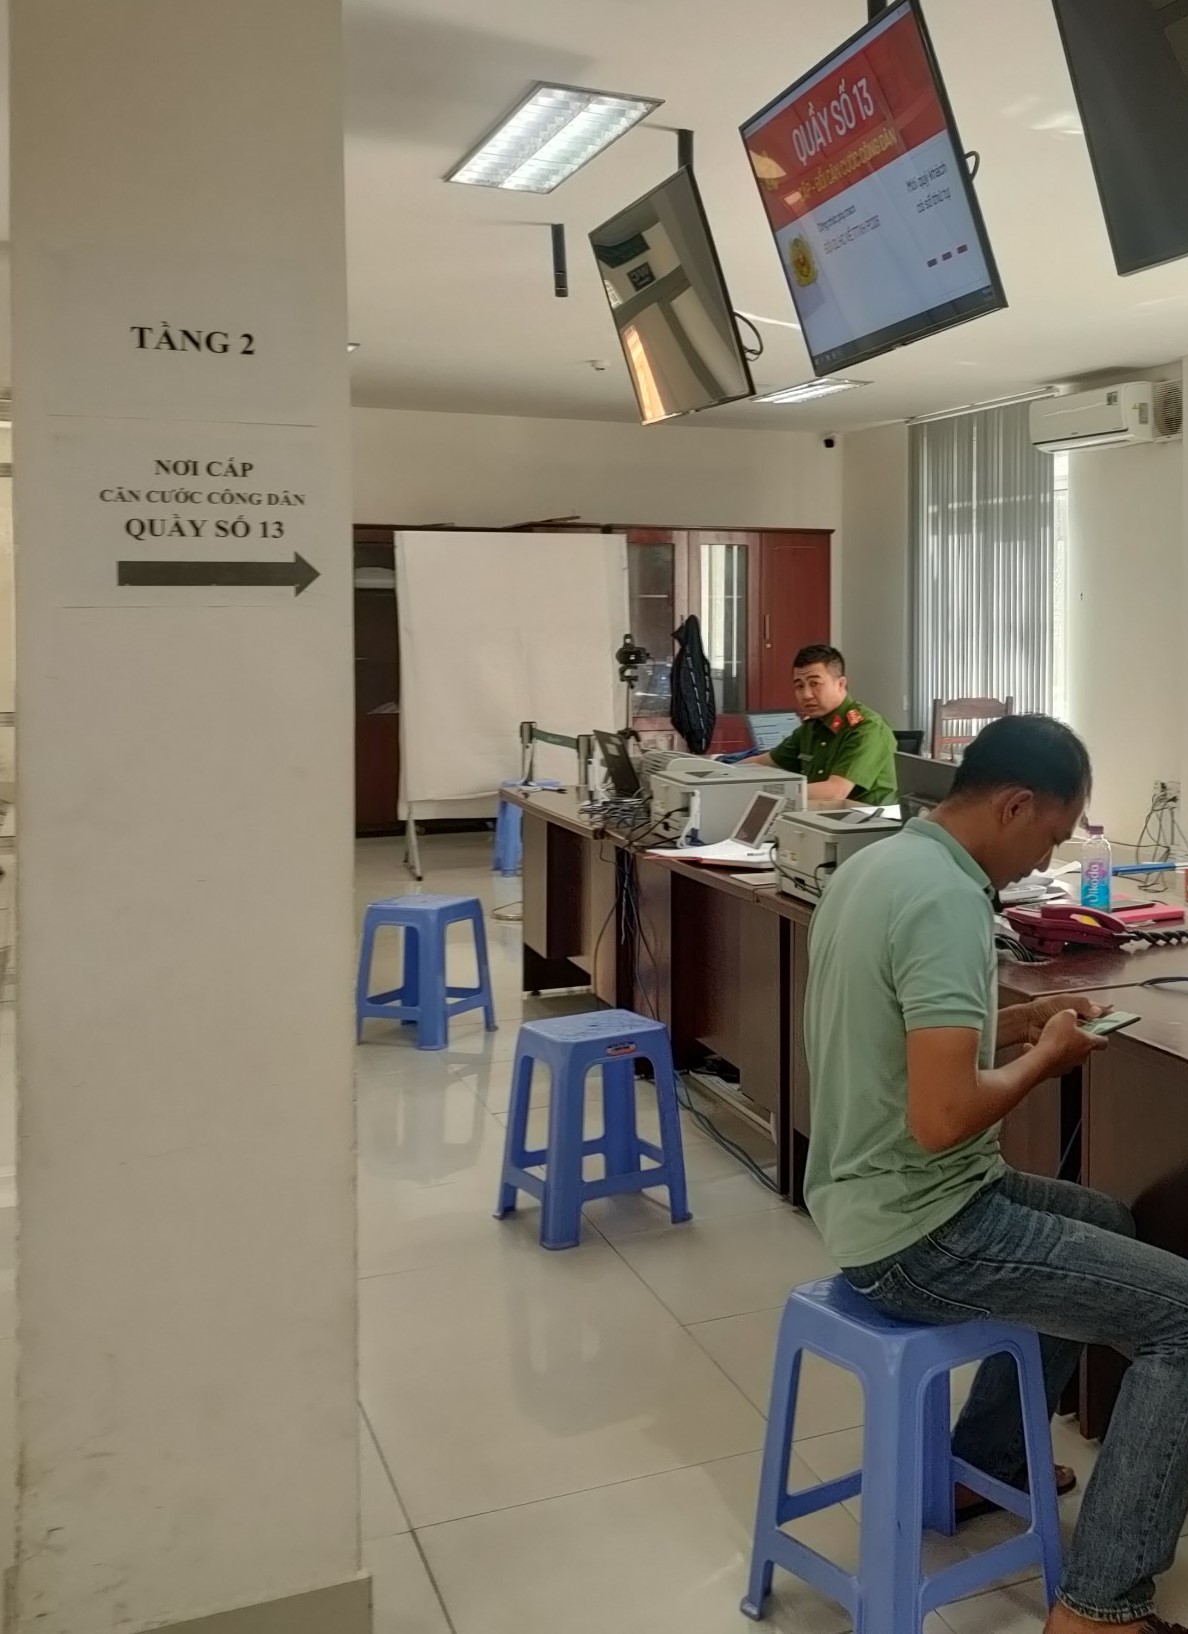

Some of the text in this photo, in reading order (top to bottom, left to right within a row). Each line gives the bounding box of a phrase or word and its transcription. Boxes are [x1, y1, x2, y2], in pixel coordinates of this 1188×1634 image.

[791, 78, 874, 167] QUẦY SỐ 13
[129, 320, 256, 355] TẦNG 2
[153, 456, 255, 478] NƠI CẤP
[99, 486, 307, 507] CĂN CƯỚC CÔNG DÂN
[124, 513, 285, 541] QUẦY SỐ 13
